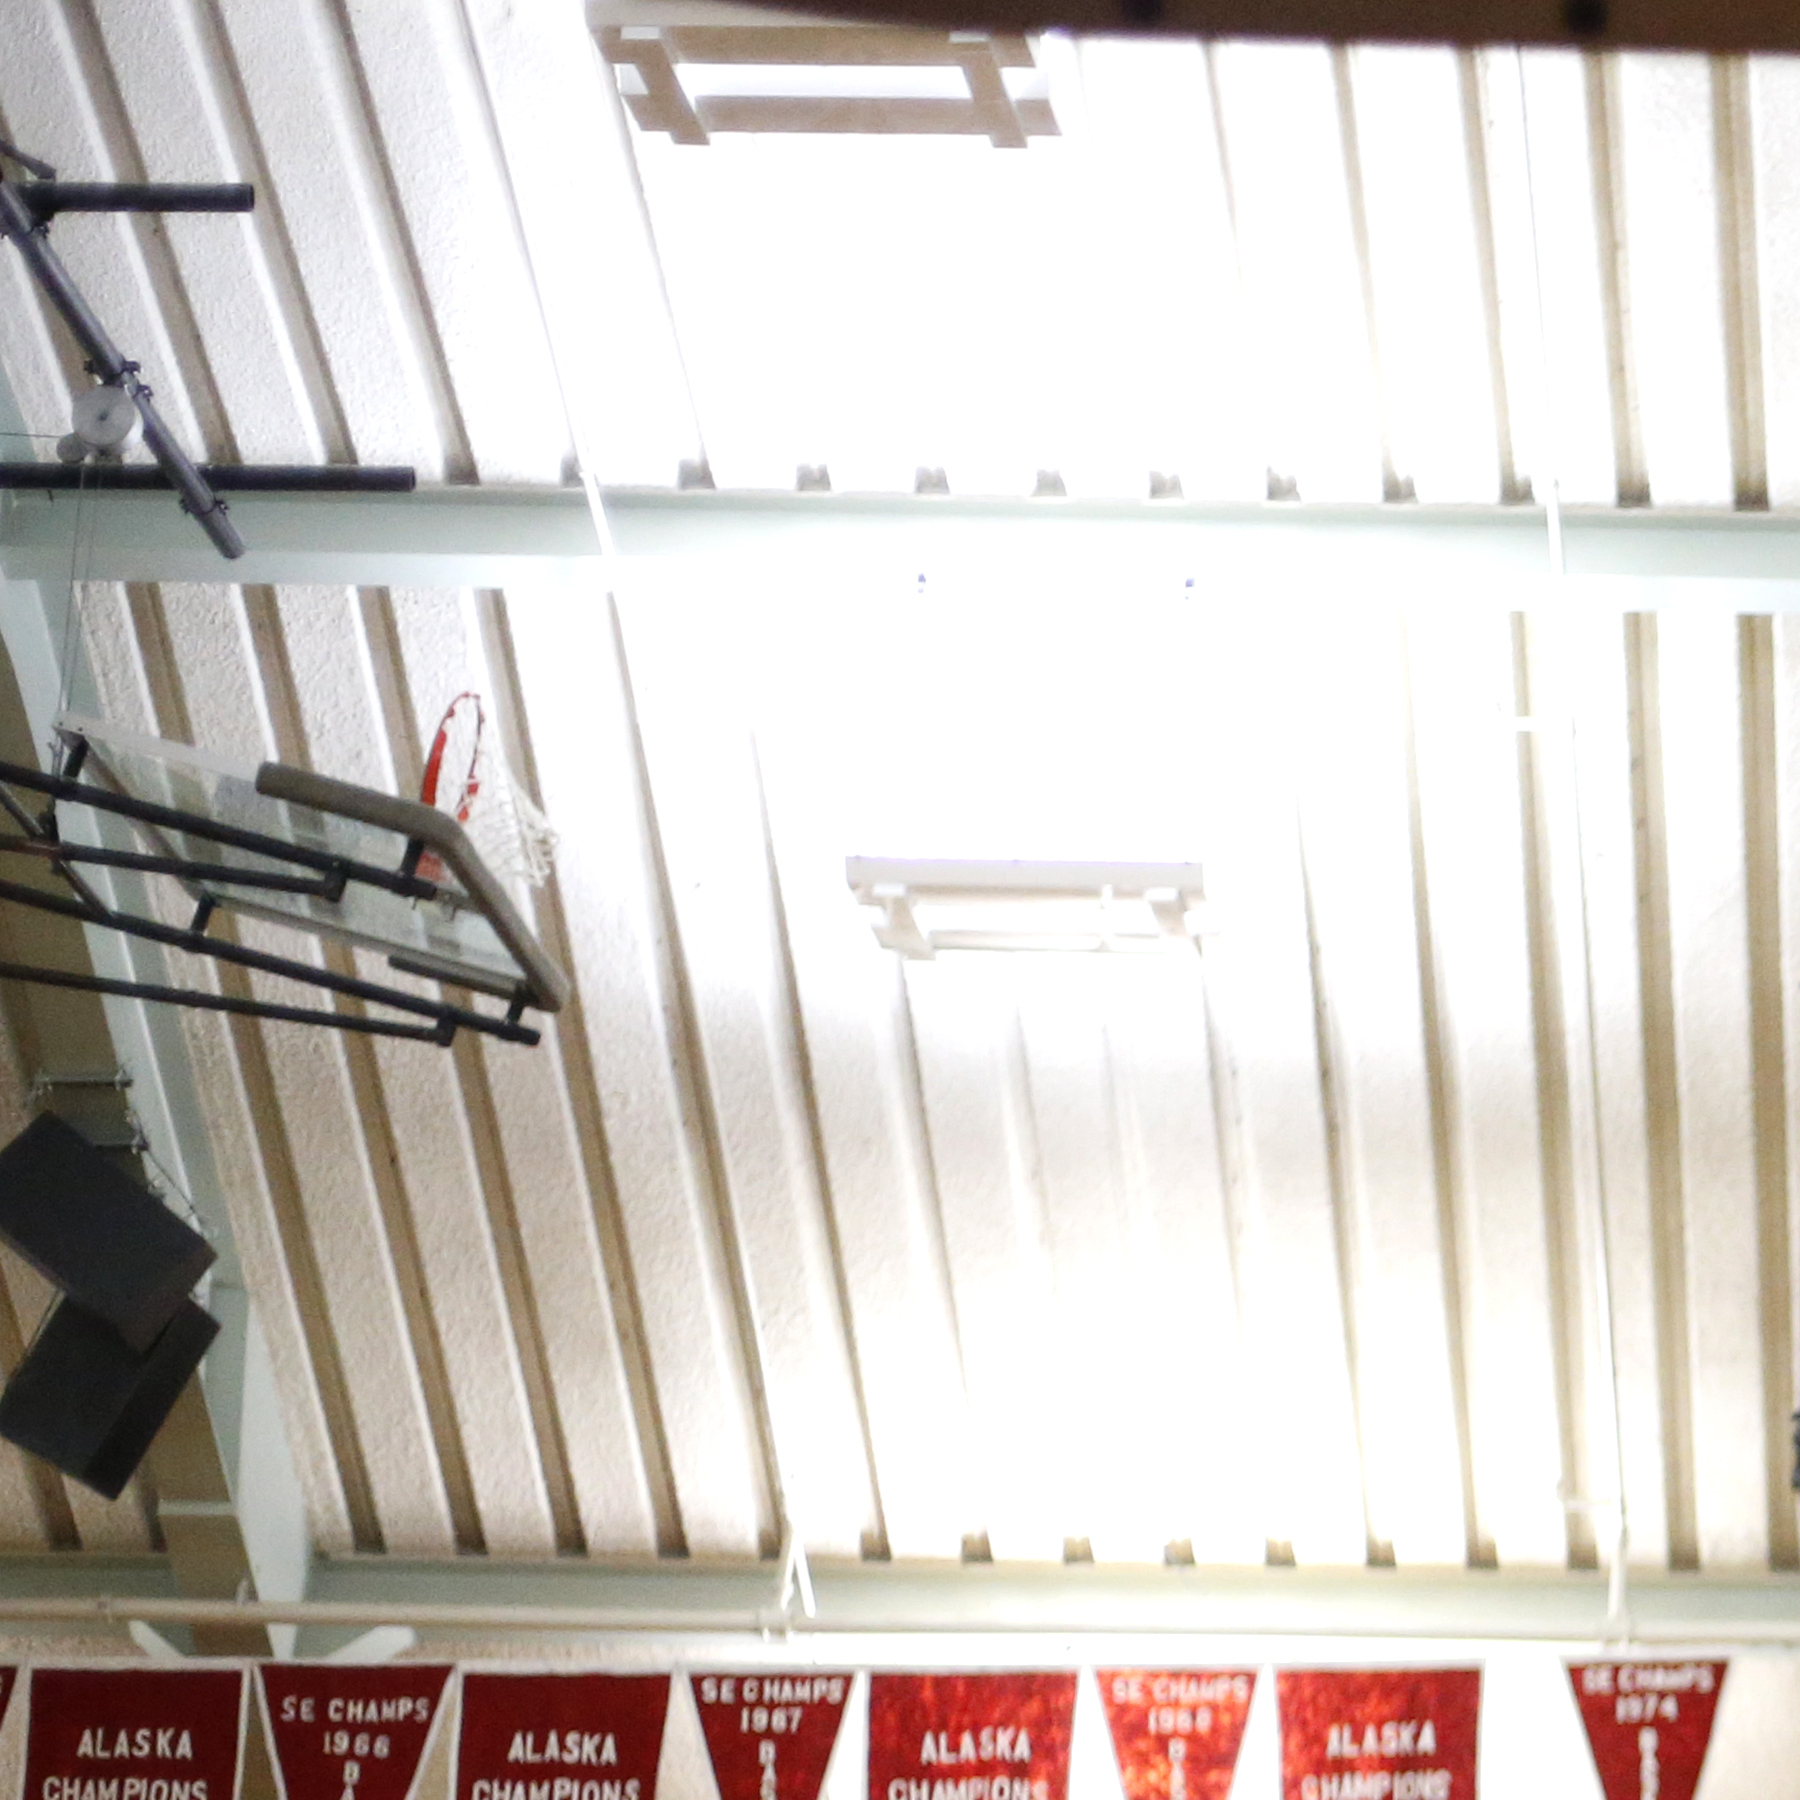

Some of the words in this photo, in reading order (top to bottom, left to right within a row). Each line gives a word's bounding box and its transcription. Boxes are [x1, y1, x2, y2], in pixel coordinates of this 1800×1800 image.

[701, 1677, 734, 1705] SE
[741, 1677, 845, 1705] CHAMPS
[1113, 1677, 1144, 1703] SE
[1152, 1673, 1248, 1703] CHAMPS
[1584, 1667, 1615, 1693] SE
[1620, 1665, 1713, 1695] CHAMPS
[282, 1696, 313, 1722] SE
[329, 1697, 430, 1724] CHAMPS
[740, 1708, 803, 1733] 1967
[77, 1728, 193, 1761] ALASKA
[323, 1731, 390, 1760] 1966
[507, 1732, 618, 1766] ALASKA
[920, 1729, 1032, 1764] ALASKA
[1326, 1722, 1436, 1757] ALASKA
